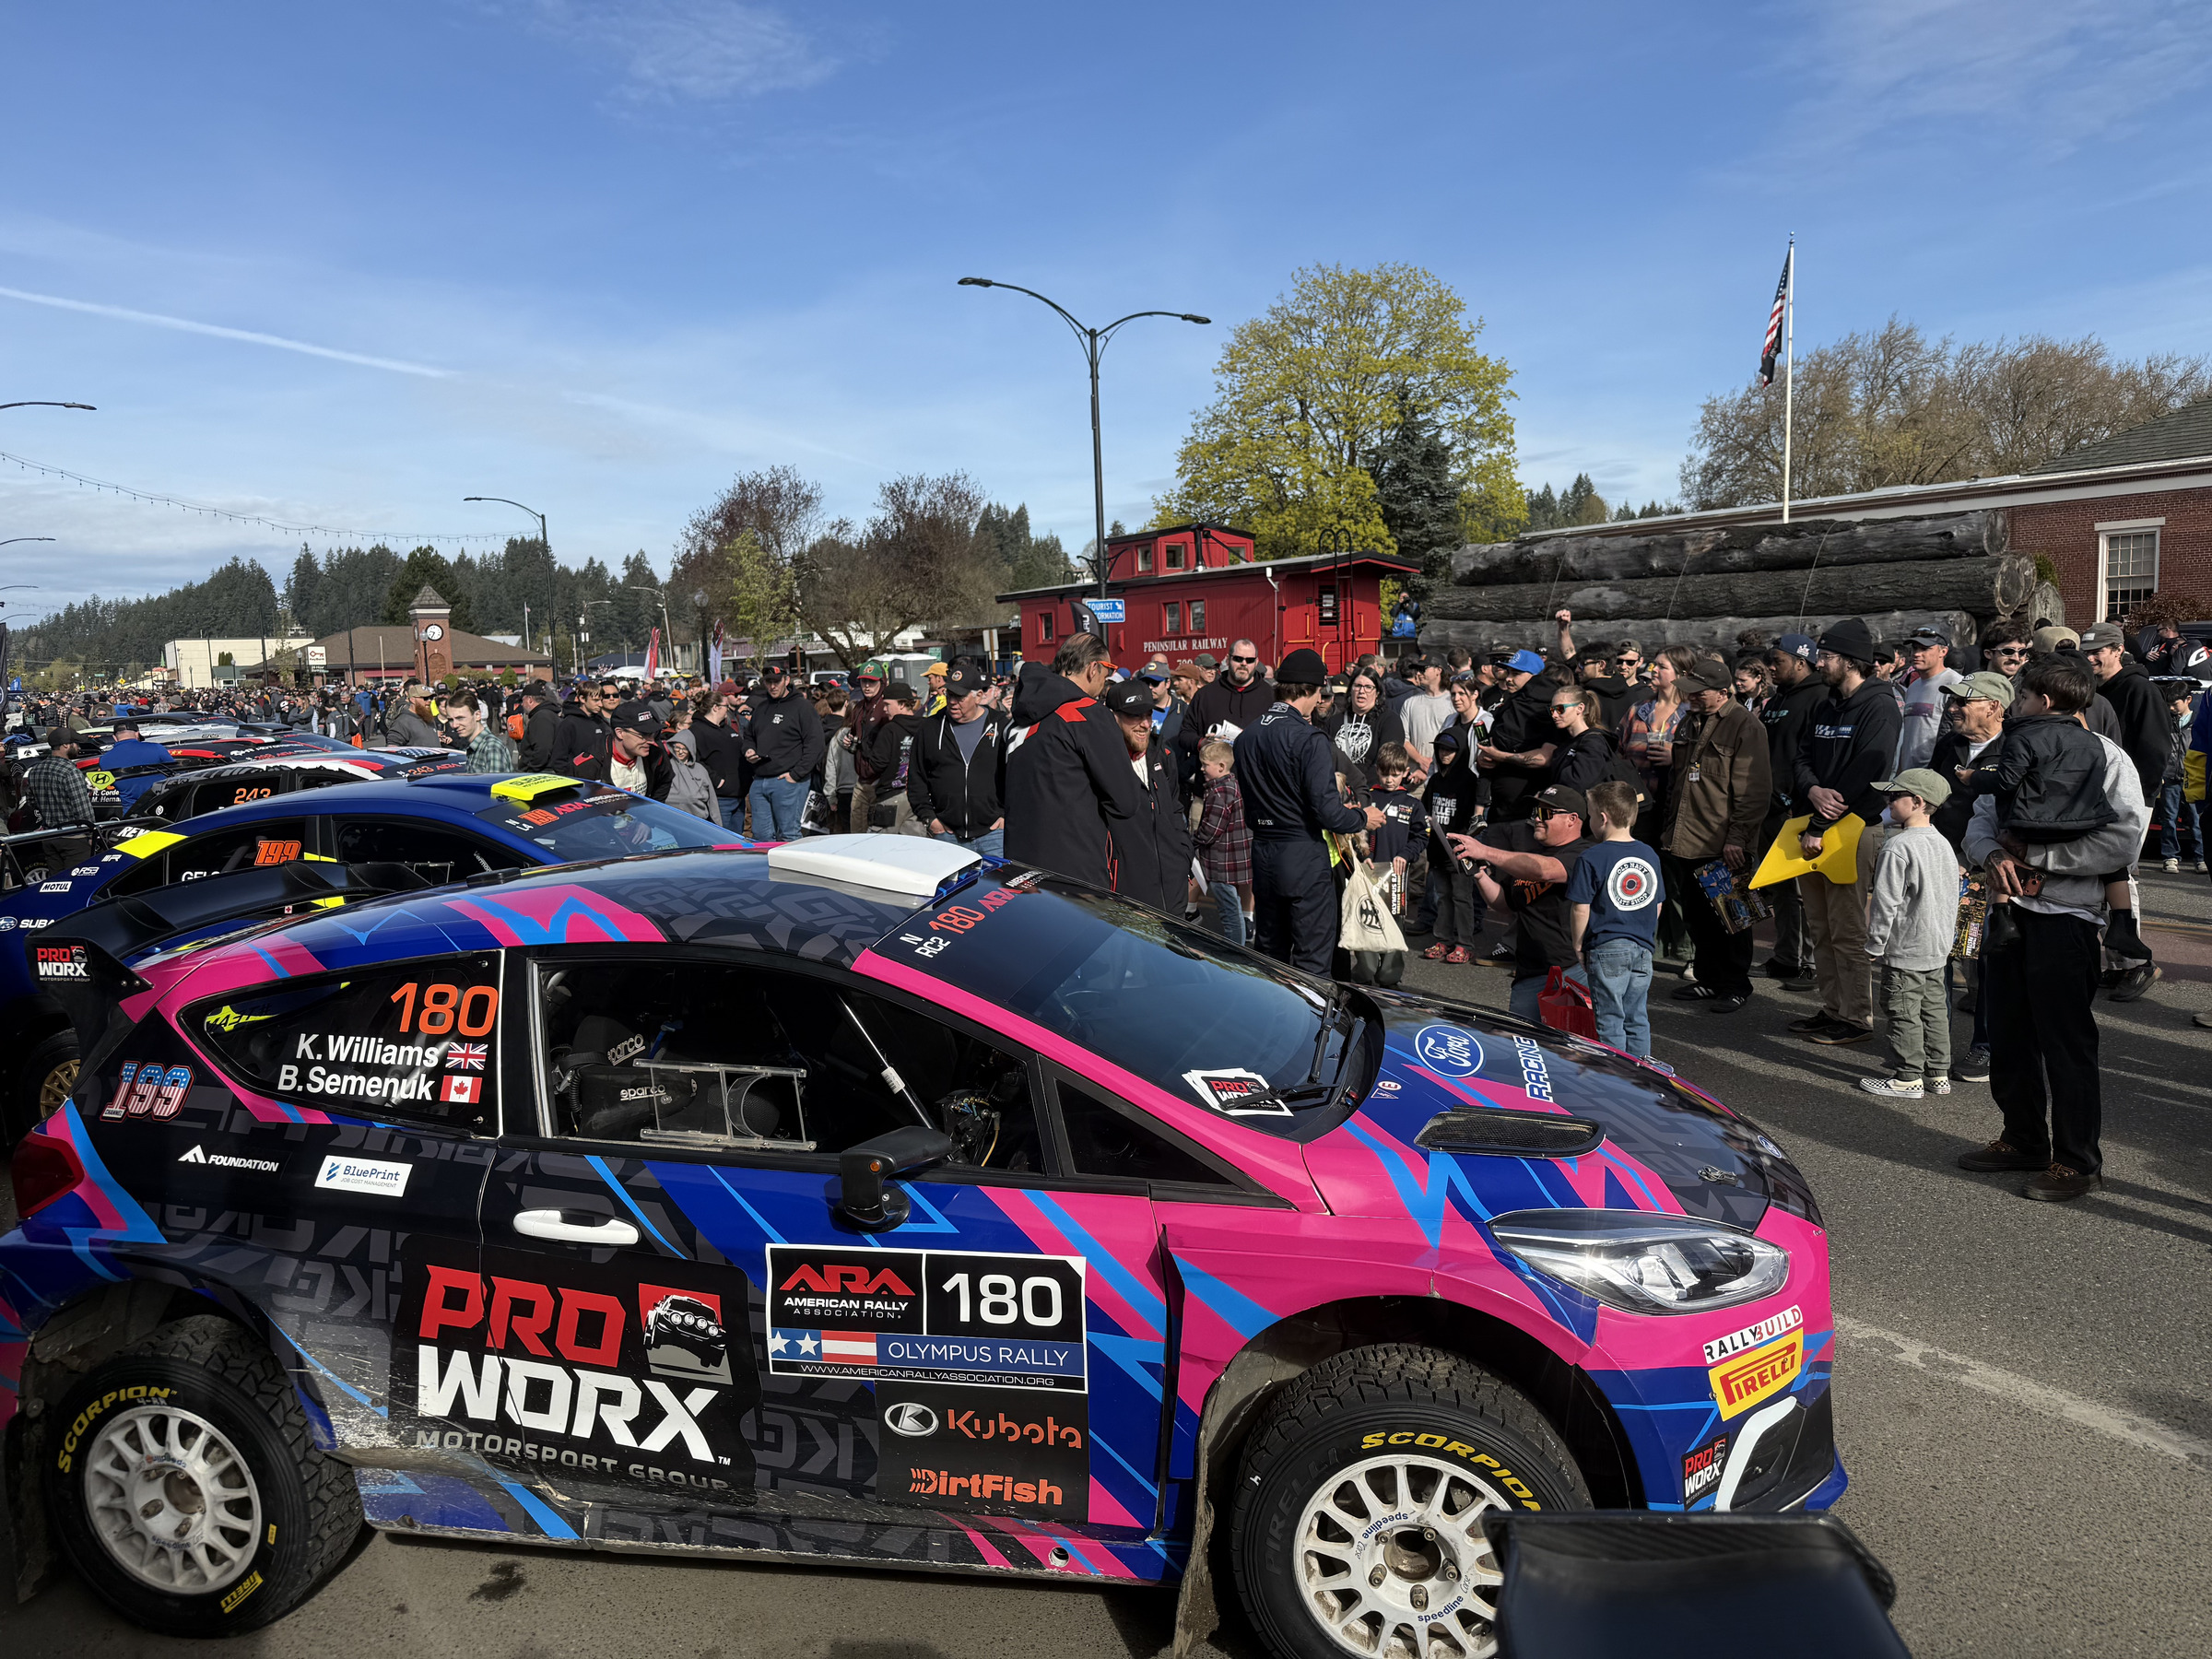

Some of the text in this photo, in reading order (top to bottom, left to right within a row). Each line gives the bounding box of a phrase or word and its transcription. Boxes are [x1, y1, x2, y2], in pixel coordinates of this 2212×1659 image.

[1144, 637, 1228, 652] PENINSULAR RAILWAY
[234, 788, 271, 805] 243
[254, 841, 301, 865] 199
[1617, 863, 1649, 875] OLD NAVY
[1630, 892, 1648, 905] SHOP
[900, 888, 1023, 945] N 180 ARA
[37, 947, 70, 961] PRO
[914, 936, 951, 958] RC2
[38, 962, 88, 976] WORX
[391, 982, 499, 1036] 180
[1424, 1030, 1472, 1067] Ford
[1512, 1034, 1554, 1103] RACING
[100, 1061, 194, 1123] 199
[1210, 1080, 1249, 1092] PRO
[104, 1109, 124, 1117] CHANNEL
[208, 1154, 278, 1171] FOUNDATION
[363, 1180, 396, 1188] MANAGEMENT
[779, 1264, 915, 1296] ARA
[784, 1297, 909, 1311] AMERICAN RALLY
[794, 1308, 896, 1319] ASSOCIATION
[942, 1273, 1063, 1326] 180
[418, 1264, 627, 1368] PRO
[888, 1342, 1069, 1367] OLYMPUS RALLY
[800, 1365, 1055, 1386] WWW.AMERICANRALLYASSOCIATION.ORG
[1719, 1342, 1796, 1406] PIRELLI
[418, 1344, 719, 1464] WORX
[58, 1385, 171, 1473] SCORPION
[947, 1408, 1082, 1449] Kubota
[417, 1430, 728, 1490] MOTORSPORT GROUP
[1685, 1448, 1713, 1478] PRO
[909, 1467, 1063, 1505] DirtFish
[1685, 1459, 1723, 1498] WORX
[1265, 1447, 1339, 1576] PIRELLI
[1362, 1512, 1408, 1539] speedline
[152, 1535, 192, 1549] speedline
[220, 1570, 264, 1613] PIRELLI
[1418, 1574, 1470, 1623] speedline Corse
